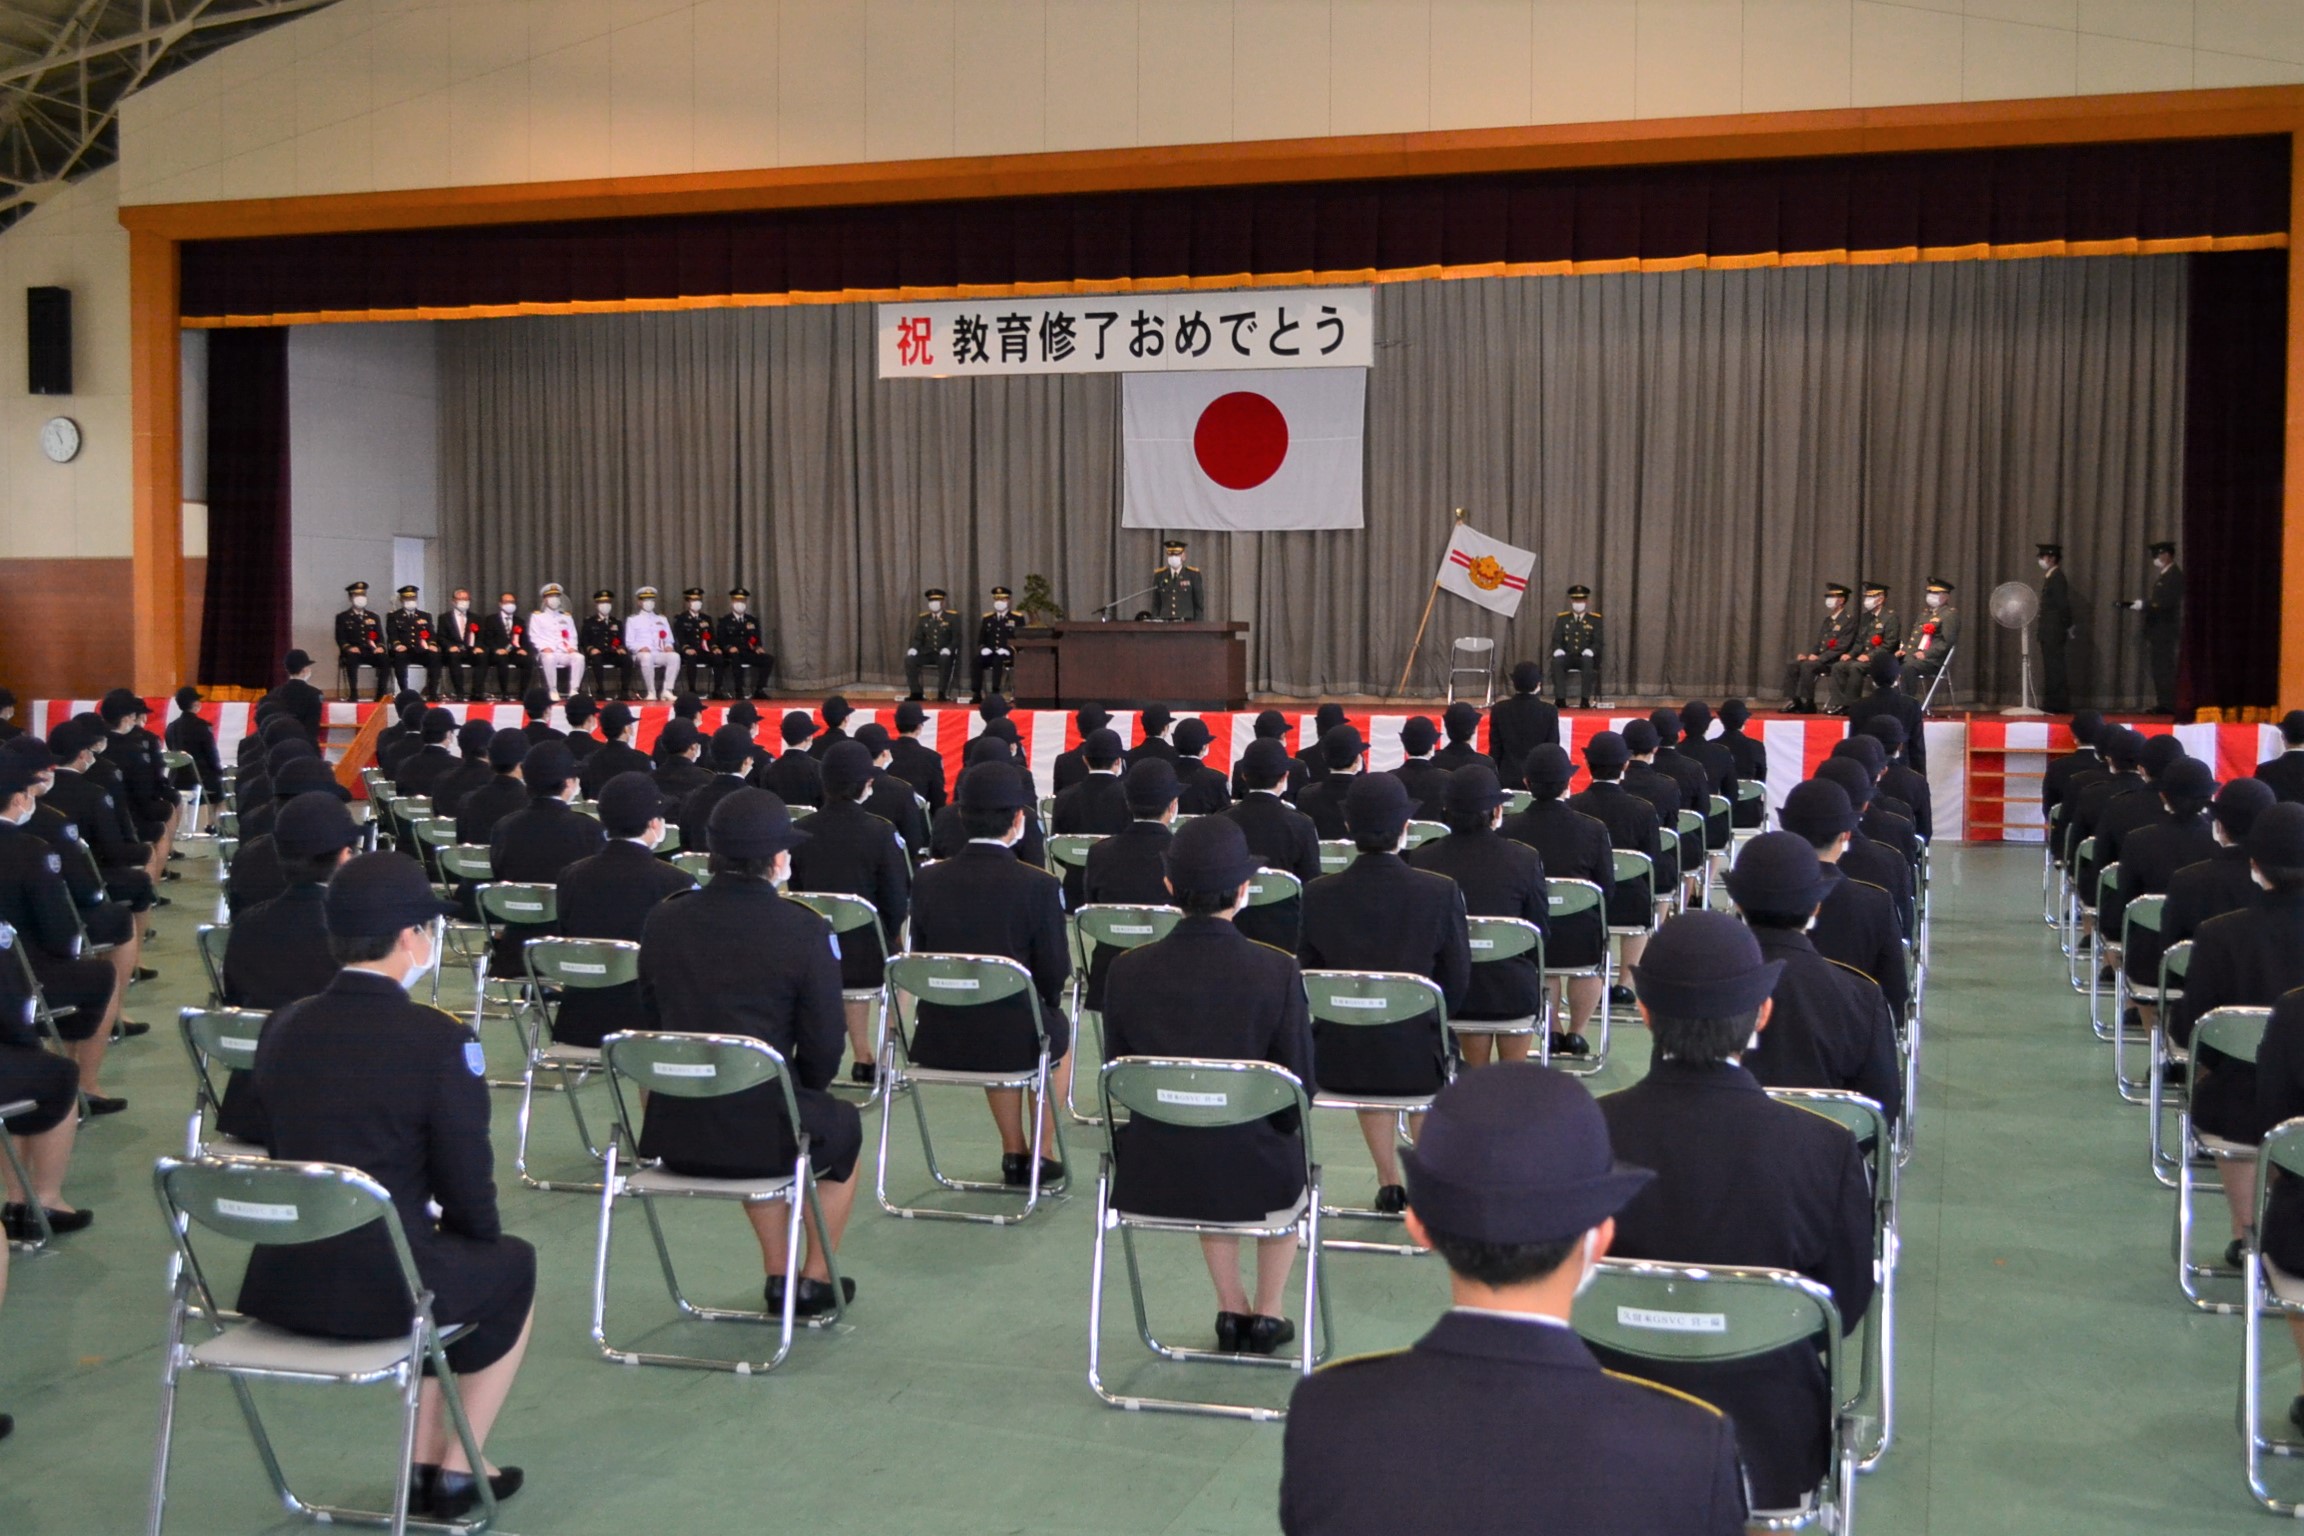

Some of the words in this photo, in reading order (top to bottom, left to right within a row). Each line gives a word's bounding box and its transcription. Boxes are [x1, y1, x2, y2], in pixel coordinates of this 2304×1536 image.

[896, 316, 934, 366] 祝
[952, 305, 1345, 364] 教育修了おめでとう
